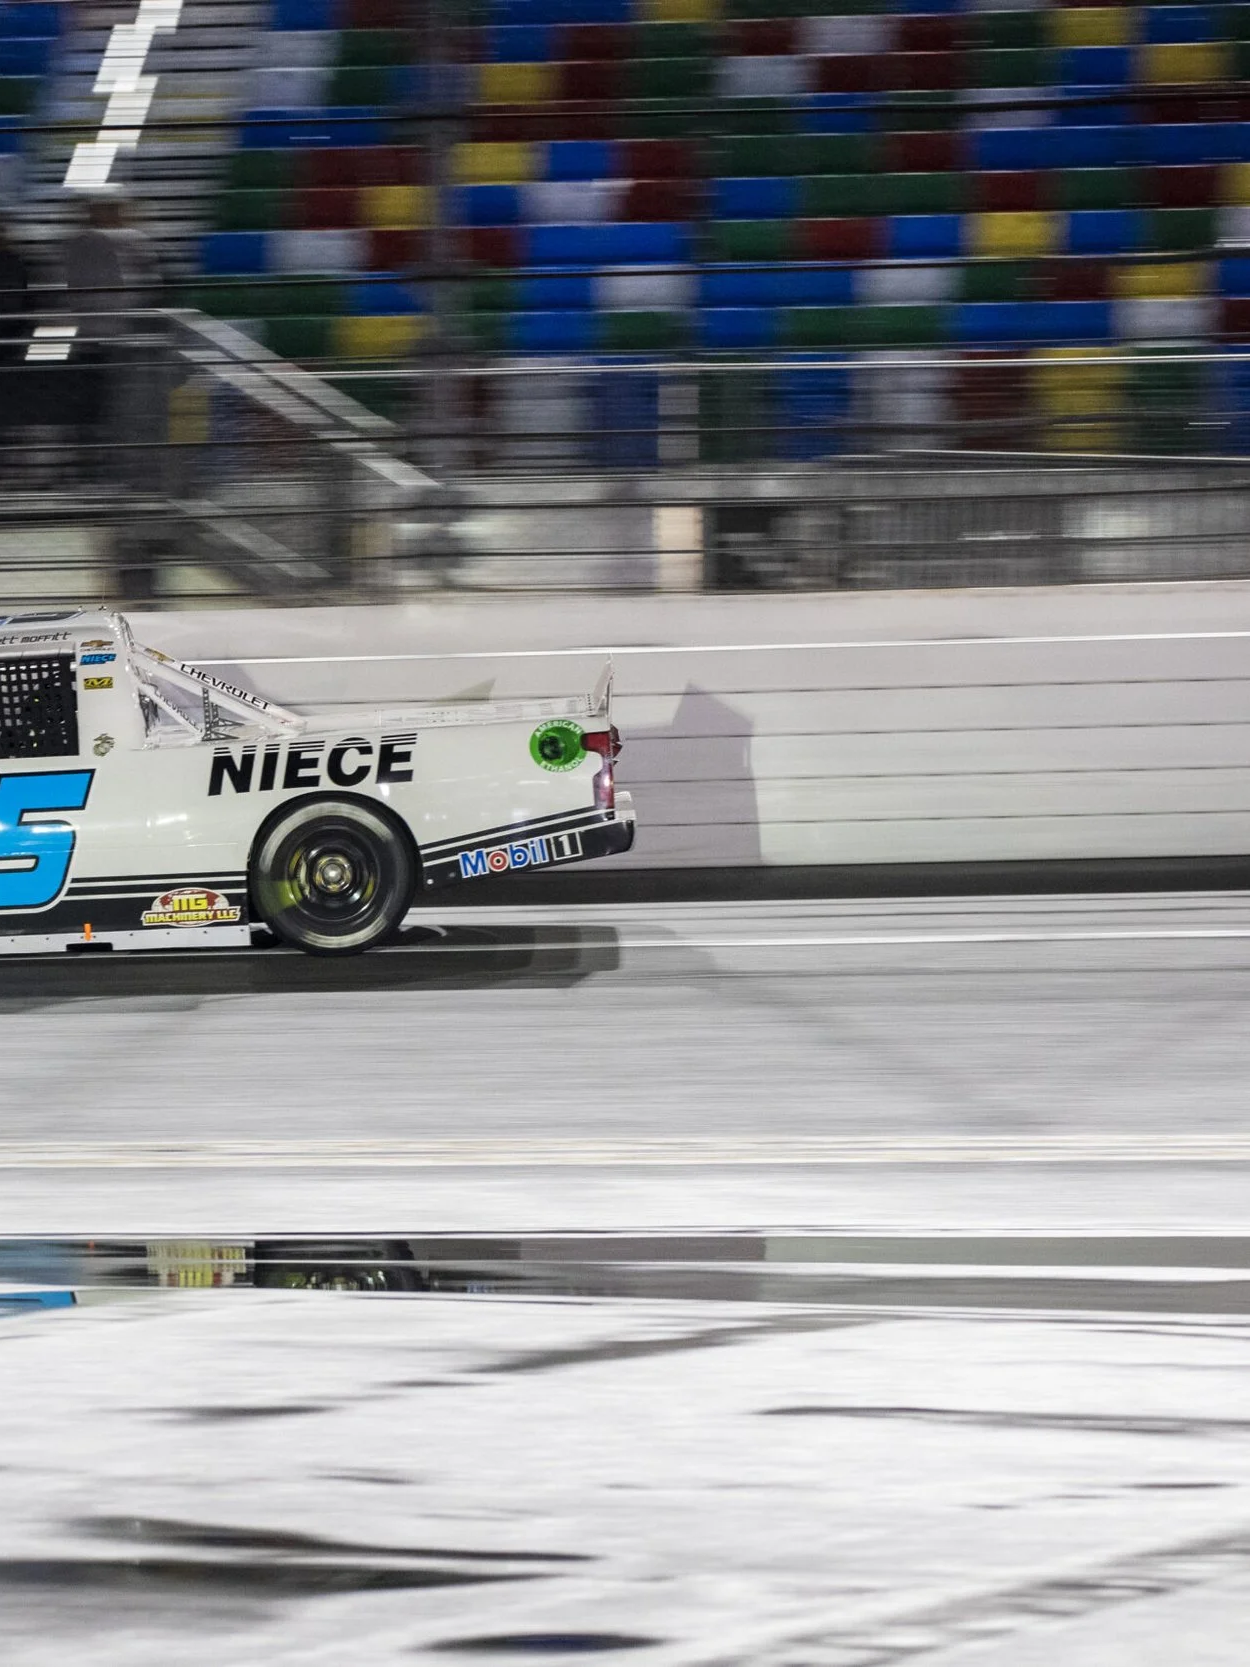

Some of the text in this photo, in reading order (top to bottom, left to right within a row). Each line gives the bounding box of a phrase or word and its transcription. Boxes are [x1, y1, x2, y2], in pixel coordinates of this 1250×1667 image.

[180, 663, 271, 710] CHEVROLET
[534, 720, 585, 738] AMERICAN
[208, 733, 418, 796] NIECE
[540, 757, 583, 773] ETHANOL
[458, 836, 550, 879] Mobil
[145, 909, 238, 923] MACHINERY LLC
